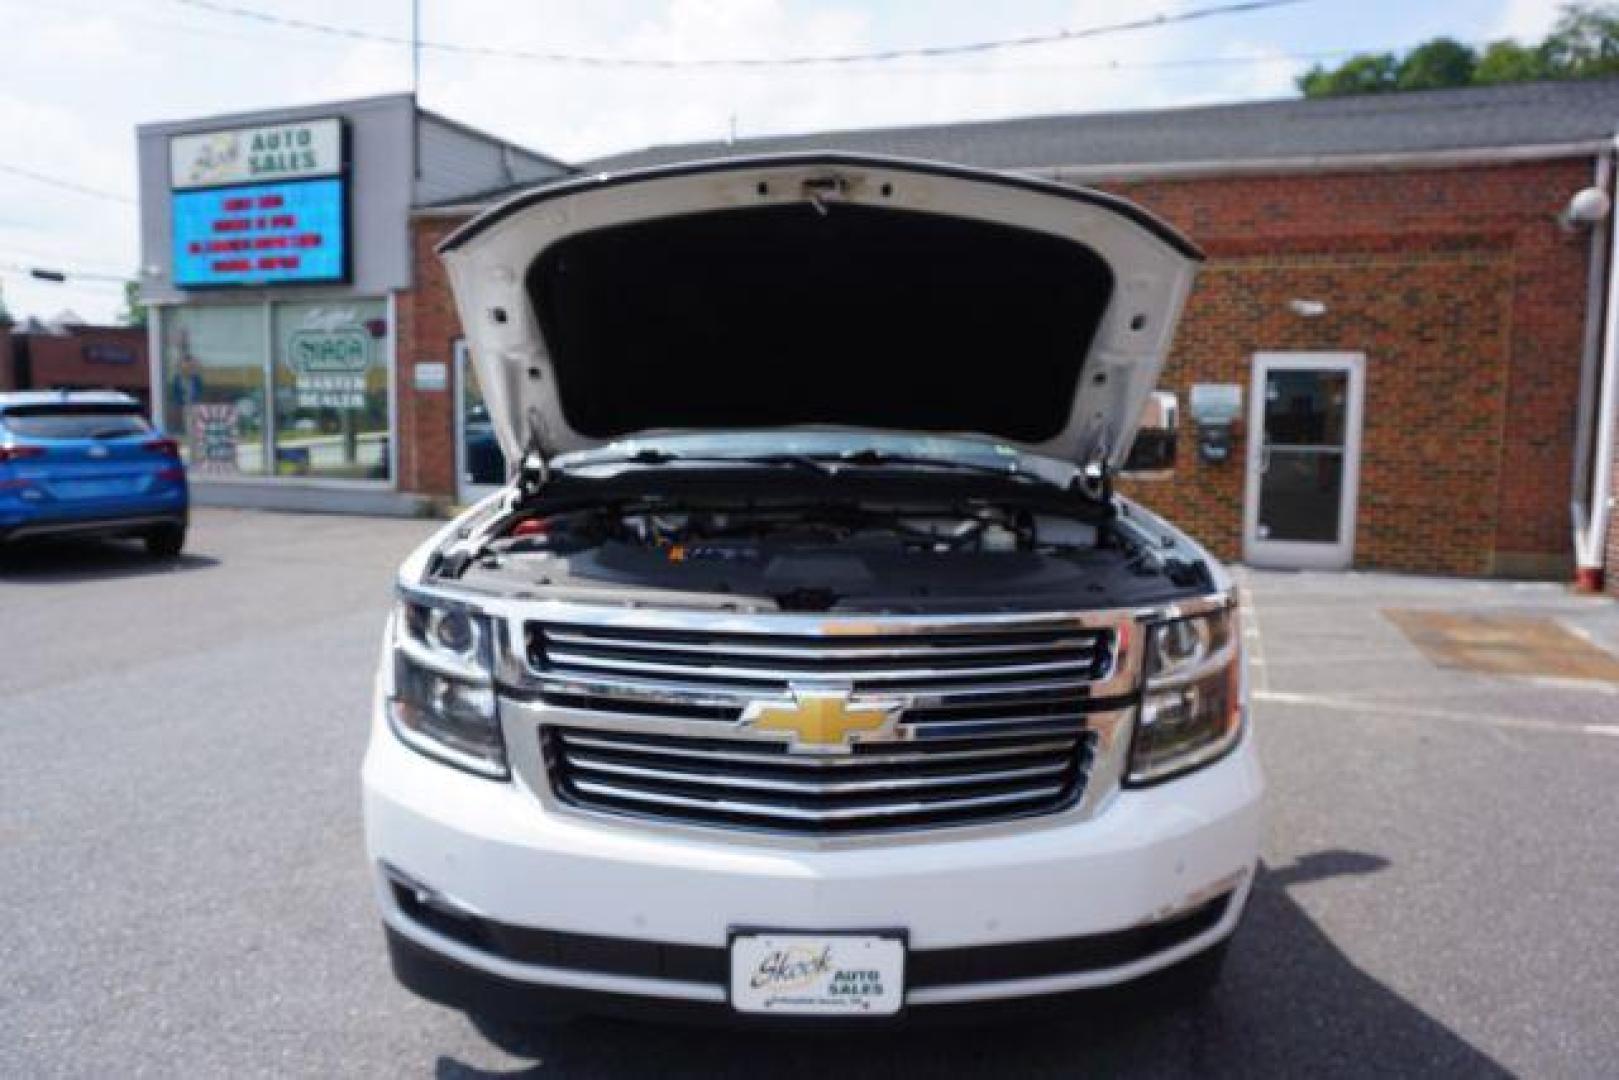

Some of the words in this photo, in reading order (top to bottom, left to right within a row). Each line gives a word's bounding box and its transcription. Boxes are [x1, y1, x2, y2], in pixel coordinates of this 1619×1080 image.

[252, 129, 311, 152] AUTO
[249, 151, 316, 174] SALES
[750, 945, 831, 989] Skook
[835, 970, 880, 981] AUTO
[829, 983, 883, 995] SALES
